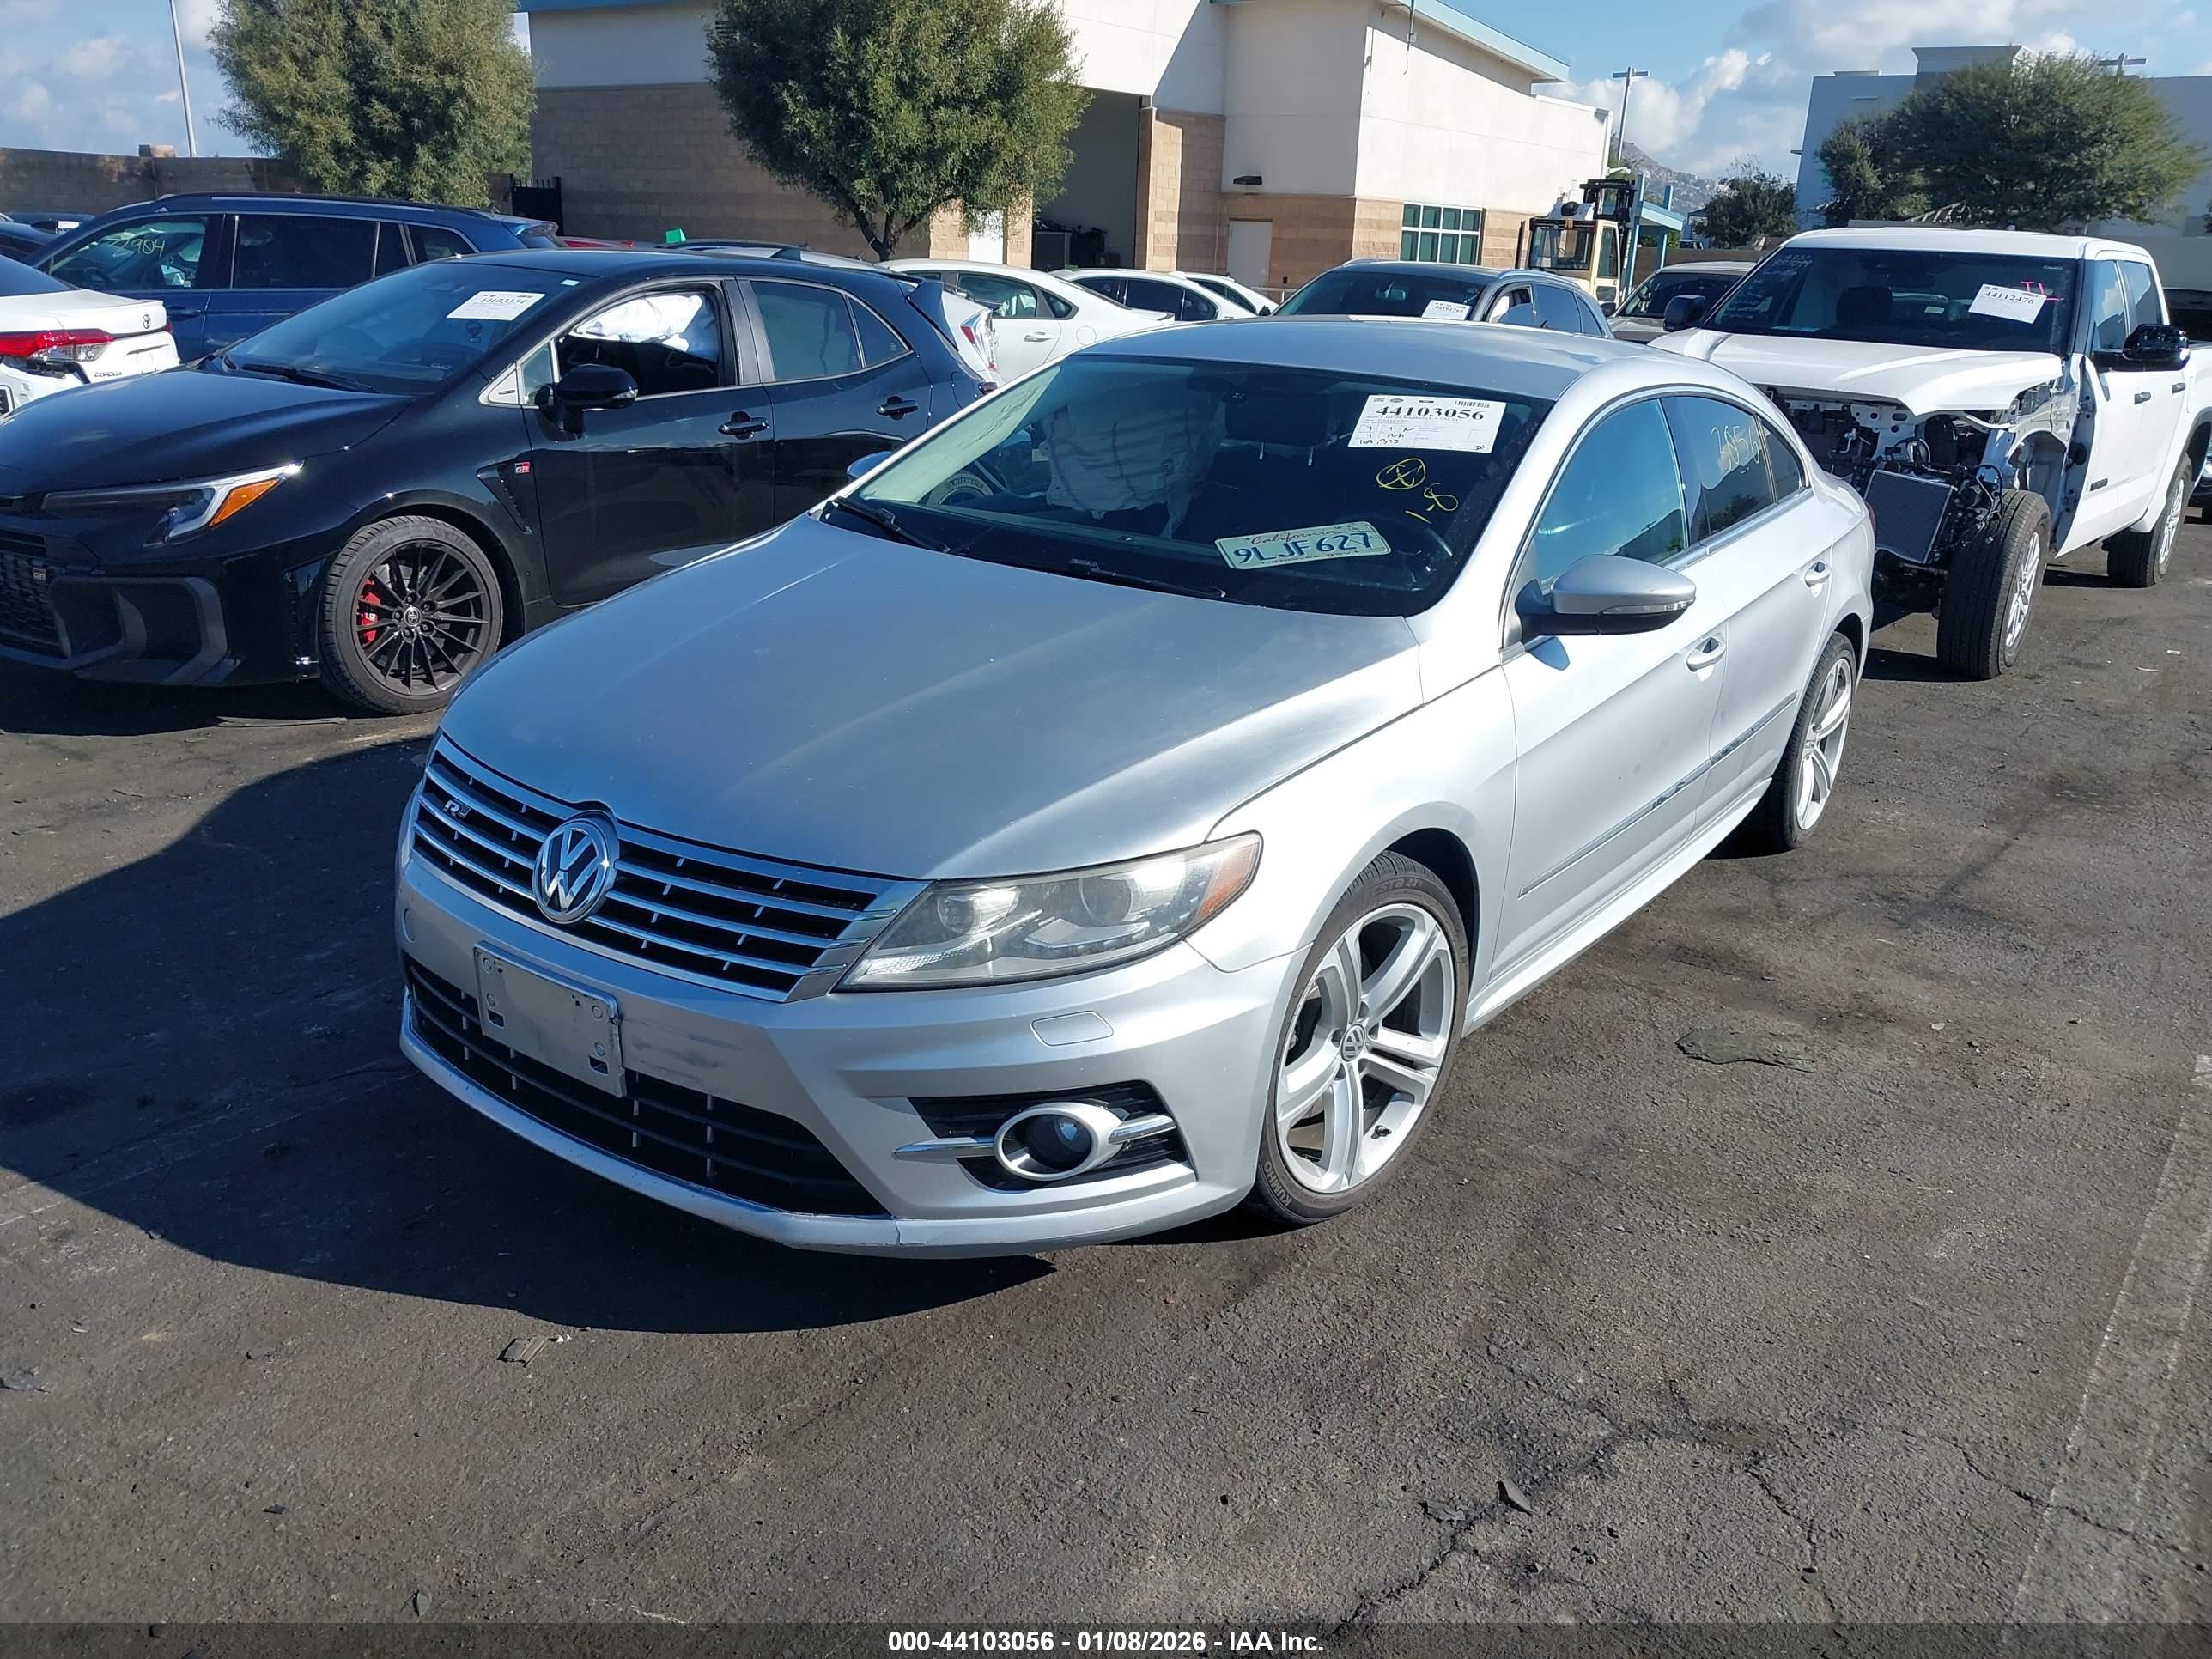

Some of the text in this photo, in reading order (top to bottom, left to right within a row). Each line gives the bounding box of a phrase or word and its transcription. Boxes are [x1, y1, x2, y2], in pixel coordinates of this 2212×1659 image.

[1984, 290, 2034, 305] 44112476
[1376, 406, 1486, 421] 44103056
[1251, 526, 1336, 545] California
[1234, 532, 1372, 564] 9LJF627
[1263, 1160, 1292, 1206] KUMHO
